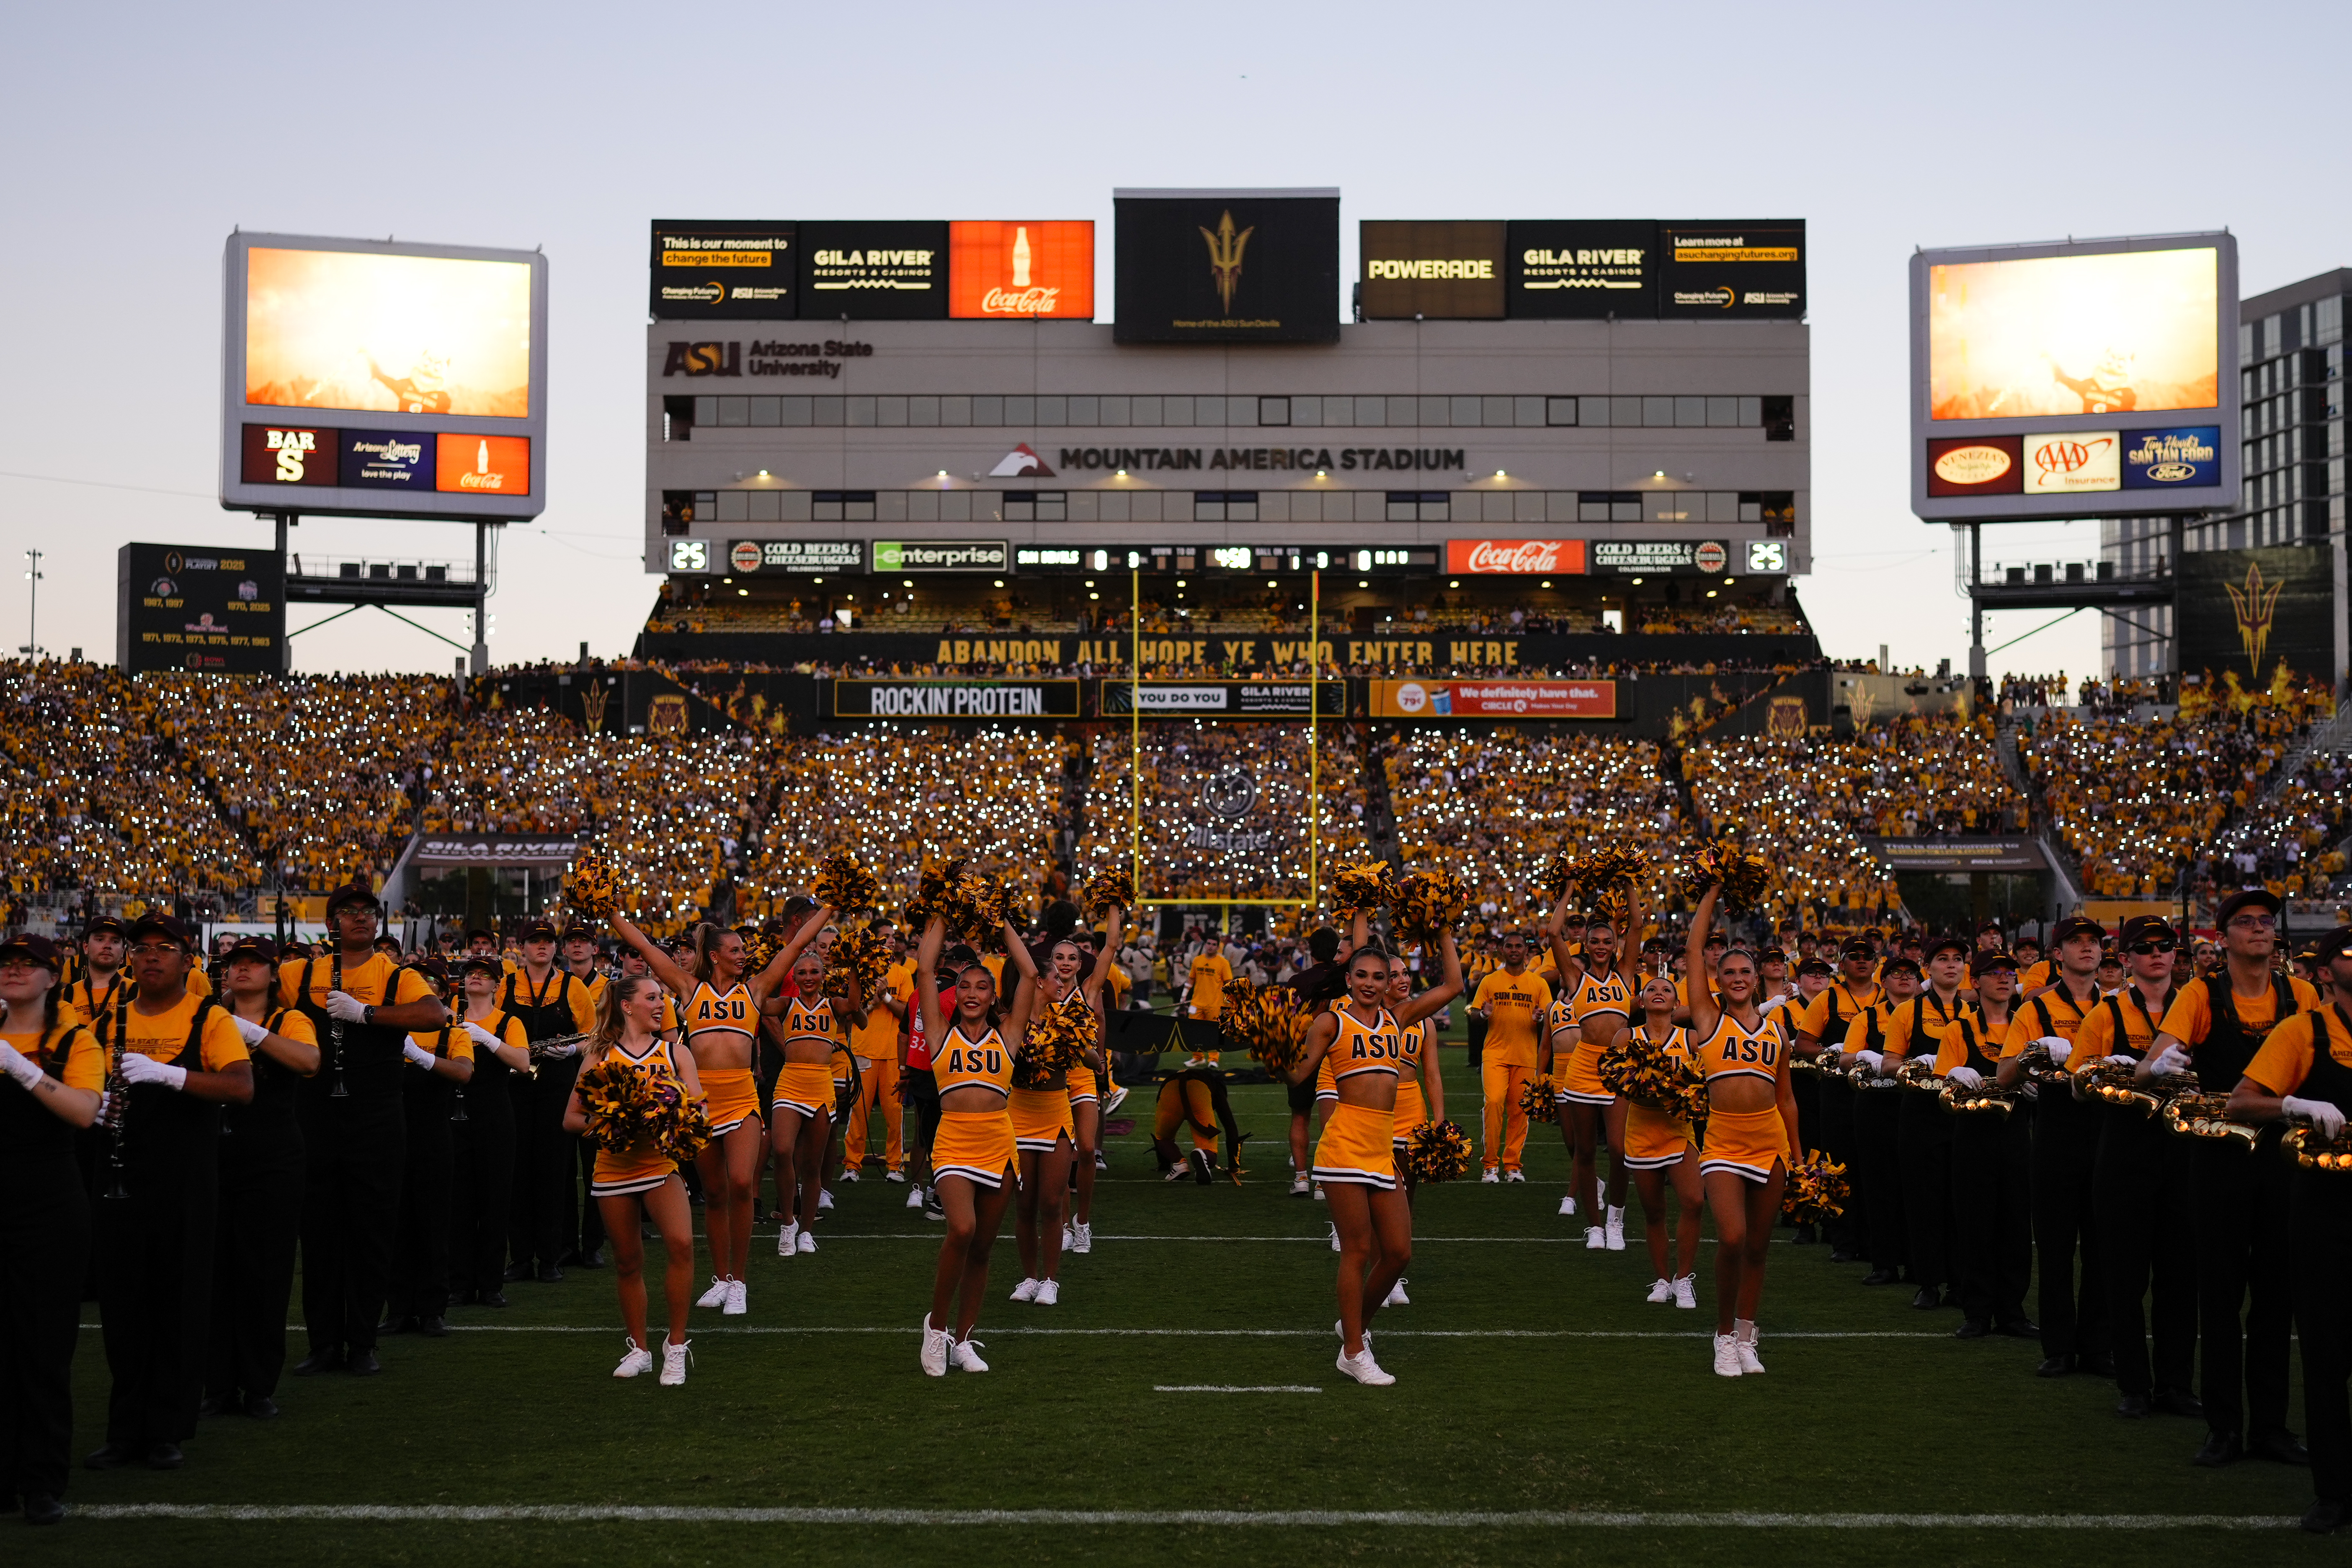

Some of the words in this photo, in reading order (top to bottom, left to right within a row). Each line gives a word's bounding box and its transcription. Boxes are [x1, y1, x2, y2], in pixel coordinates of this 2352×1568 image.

[663, 237, 690, 249] This
[690, 237, 701, 249] is
[701, 239, 723, 249] our
[723, 238, 774, 250] moment
[774, 239, 788, 250] to
[1674, 236, 1704, 247] Learn
[1704, 237, 1731, 247] more
[1733, 236, 1744, 246] at
[666, 253, 708, 264] change
[712, 254, 730, 263] the
[732, 254, 767, 263] future
[814, 250, 864, 266] GILA
[867, 250, 931, 266] RIVER
[1524, 249, 1574, 265] GILA
[1577, 249, 1641, 265] RIVER
[1677, 250, 1795, 260] asuchangingfutures.org
[1368, 259, 1493, 279] POWERADE
[1523, 268, 1577, 276] RESORTS
[1580, 268, 1589, 276] &
[1591, 268, 1642, 276] CASINOS
[662, 286, 693, 296] Changing
[731, 287, 753, 299] ASU
[1674, 291, 1704, 301] Changing
[1743, 292, 1765, 304] ASU
[981, 286, 1060, 313] Coca-Cola
[749, 340, 820, 356] Arizona
[824, 340, 873, 357] State
[663, 342, 742, 377] ASU
[749, 360, 840, 379] University
[267, 430, 315, 450] BAR
[353, 441, 389, 453] Arizona
[379, 438, 421, 464] Lottery
[1060, 448, 1201, 469] MOUNTAIN
[1210, 449, 1334, 470] AMERICA
[1341, 449, 1465, 470] STADIUM
[1942, 451, 2006, 466] VENEZIA'S
[2042, 442, 2084, 472] AAA
[2128, 449, 2153, 465] SAN
[2155, 447, 2179, 463] TAN
[2181, 446, 2214, 462] FORD
[276, 449, 304, 482] S
[2156, 465, 2187, 478] Ford
[361, 468, 379, 478] love
[379, 469, 392, 479] the
[393, 469, 412, 482] play
[460, 472, 504, 489] Coca-Cola
[2065, 476, 2115, 485] Insurance
[765, 543, 802, 555] COLD
[805, 543, 851, 555] BEERS
[852, 544, 861, 555] &
[881, 546, 1003, 567] enterprise
[1469, 541, 1563, 572] Coca-Cola
[1595, 543, 1632, 555] COLD
[1635, 543, 1682, 555] BEERS
[1684, 544, 1693, 555] &
[765, 555, 861, 565] CHEESEBURGERS
[1596, 555, 1692, 565] CHEESEBURGERS
[937, 640, 1060, 664] ABANDON
[1078, 640, 1123, 664] ALL
[1139, 640, 1207, 664] HOPE
[1222, 641, 1256, 665] YE
[1272, 641, 1333, 665] WHO
[1349, 641, 1433, 665] ENTER
[1450, 641, 1518, 665] HERE
[1139, 693, 1165, 703] YOU
[1170, 693, 1189, 703] DO
[1194, 693, 1220, 703] YOU
[1240, 686, 1271, 697] GILA
[1271, 687, 1310, 697] RIVER
[1460, 687, 1479, 698] We
[1480, 687, 1537, 700] definitely
[1540, 687, 1568, 698] have
[1569, 687, 1598, 698] that.
[871, 687, 952, 715] ROCKIN'
[954, 687, 1042, 716] PROTEIN
[1481, 701, 1512, 710] CIRCLE
[1184, 825, 1271, 851] Allstate
[495, 842, 577, 852] RIVER
[1494, 992, 1510, 1001] SUN
[1512, 992, 1532, 1002] DEVIL
[1586, 985, 1625, 1004] ASU
[697, 1000, 745, 1020] ASU
[1552, 1007, 1572, 1026] AS
[791, 1013, 830, 1033] ASU
[910, 1036, 926, 1052] 32
[1351, 1033, 1399, 1060] ASU
[1721, 1035, 1777, 1067] ASU
[948, 1048, 1001, 1075] ASU
